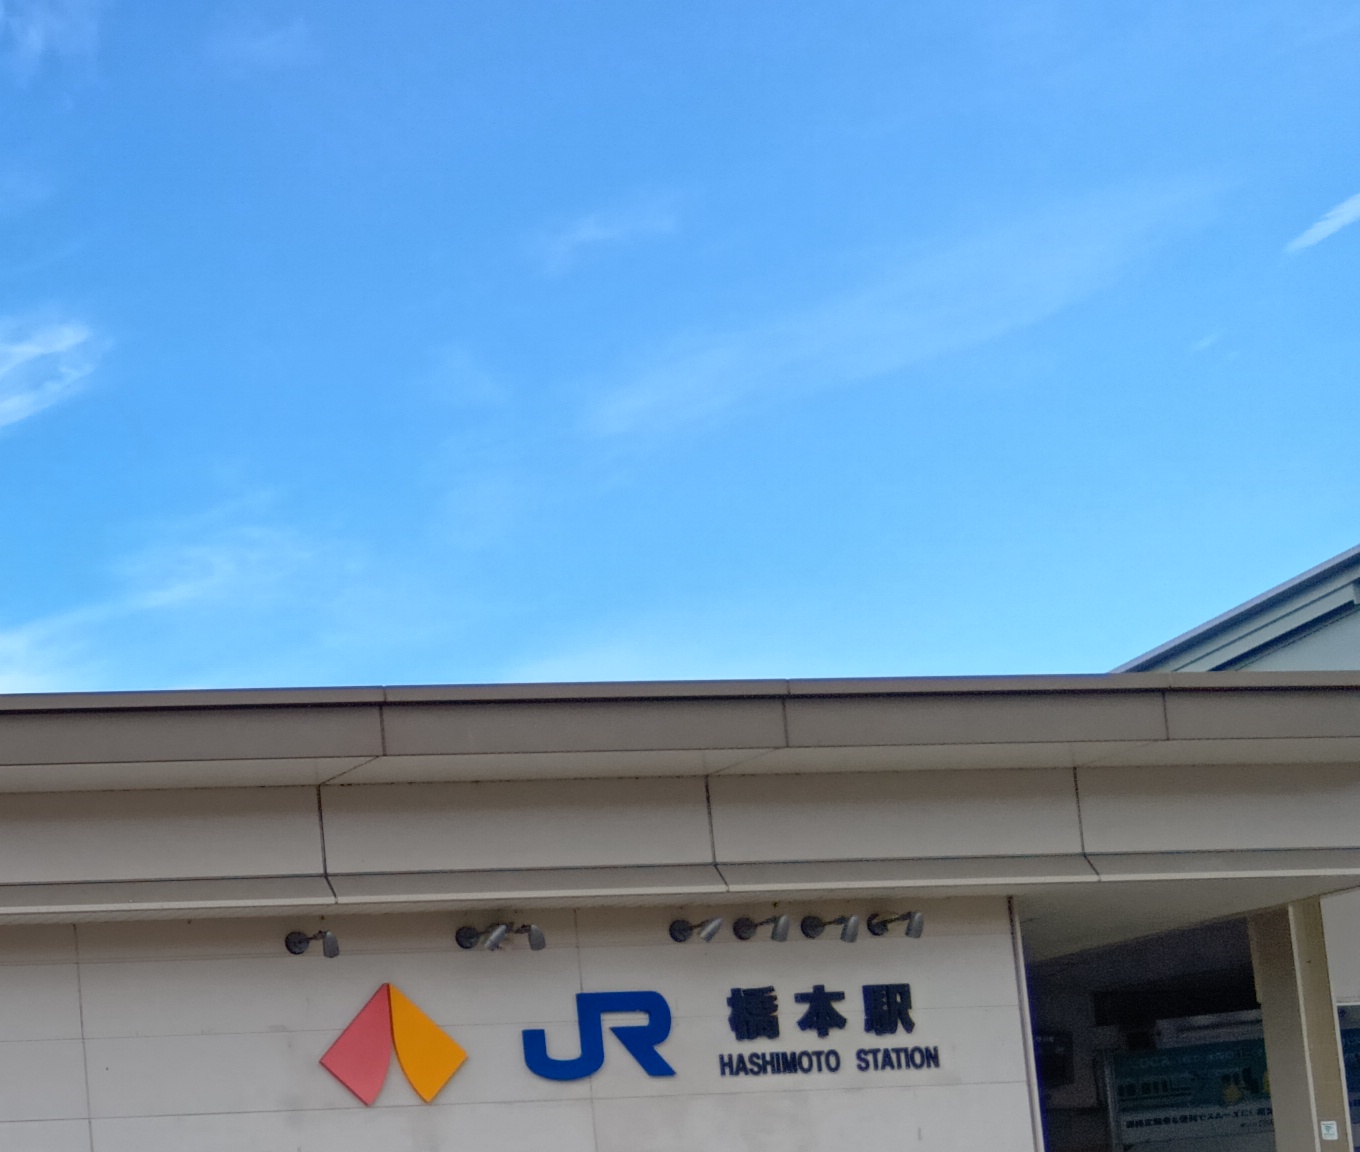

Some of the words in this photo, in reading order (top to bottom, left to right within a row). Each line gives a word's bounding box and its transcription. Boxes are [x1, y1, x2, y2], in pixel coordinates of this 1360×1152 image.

[522, 990, 677, 1081] JR
[726, 983, 916, 1041] 橋本駅
[719, 1050, 841, 1076] HASHIMOTO
[856, 1046, 940, 1072] STATION
